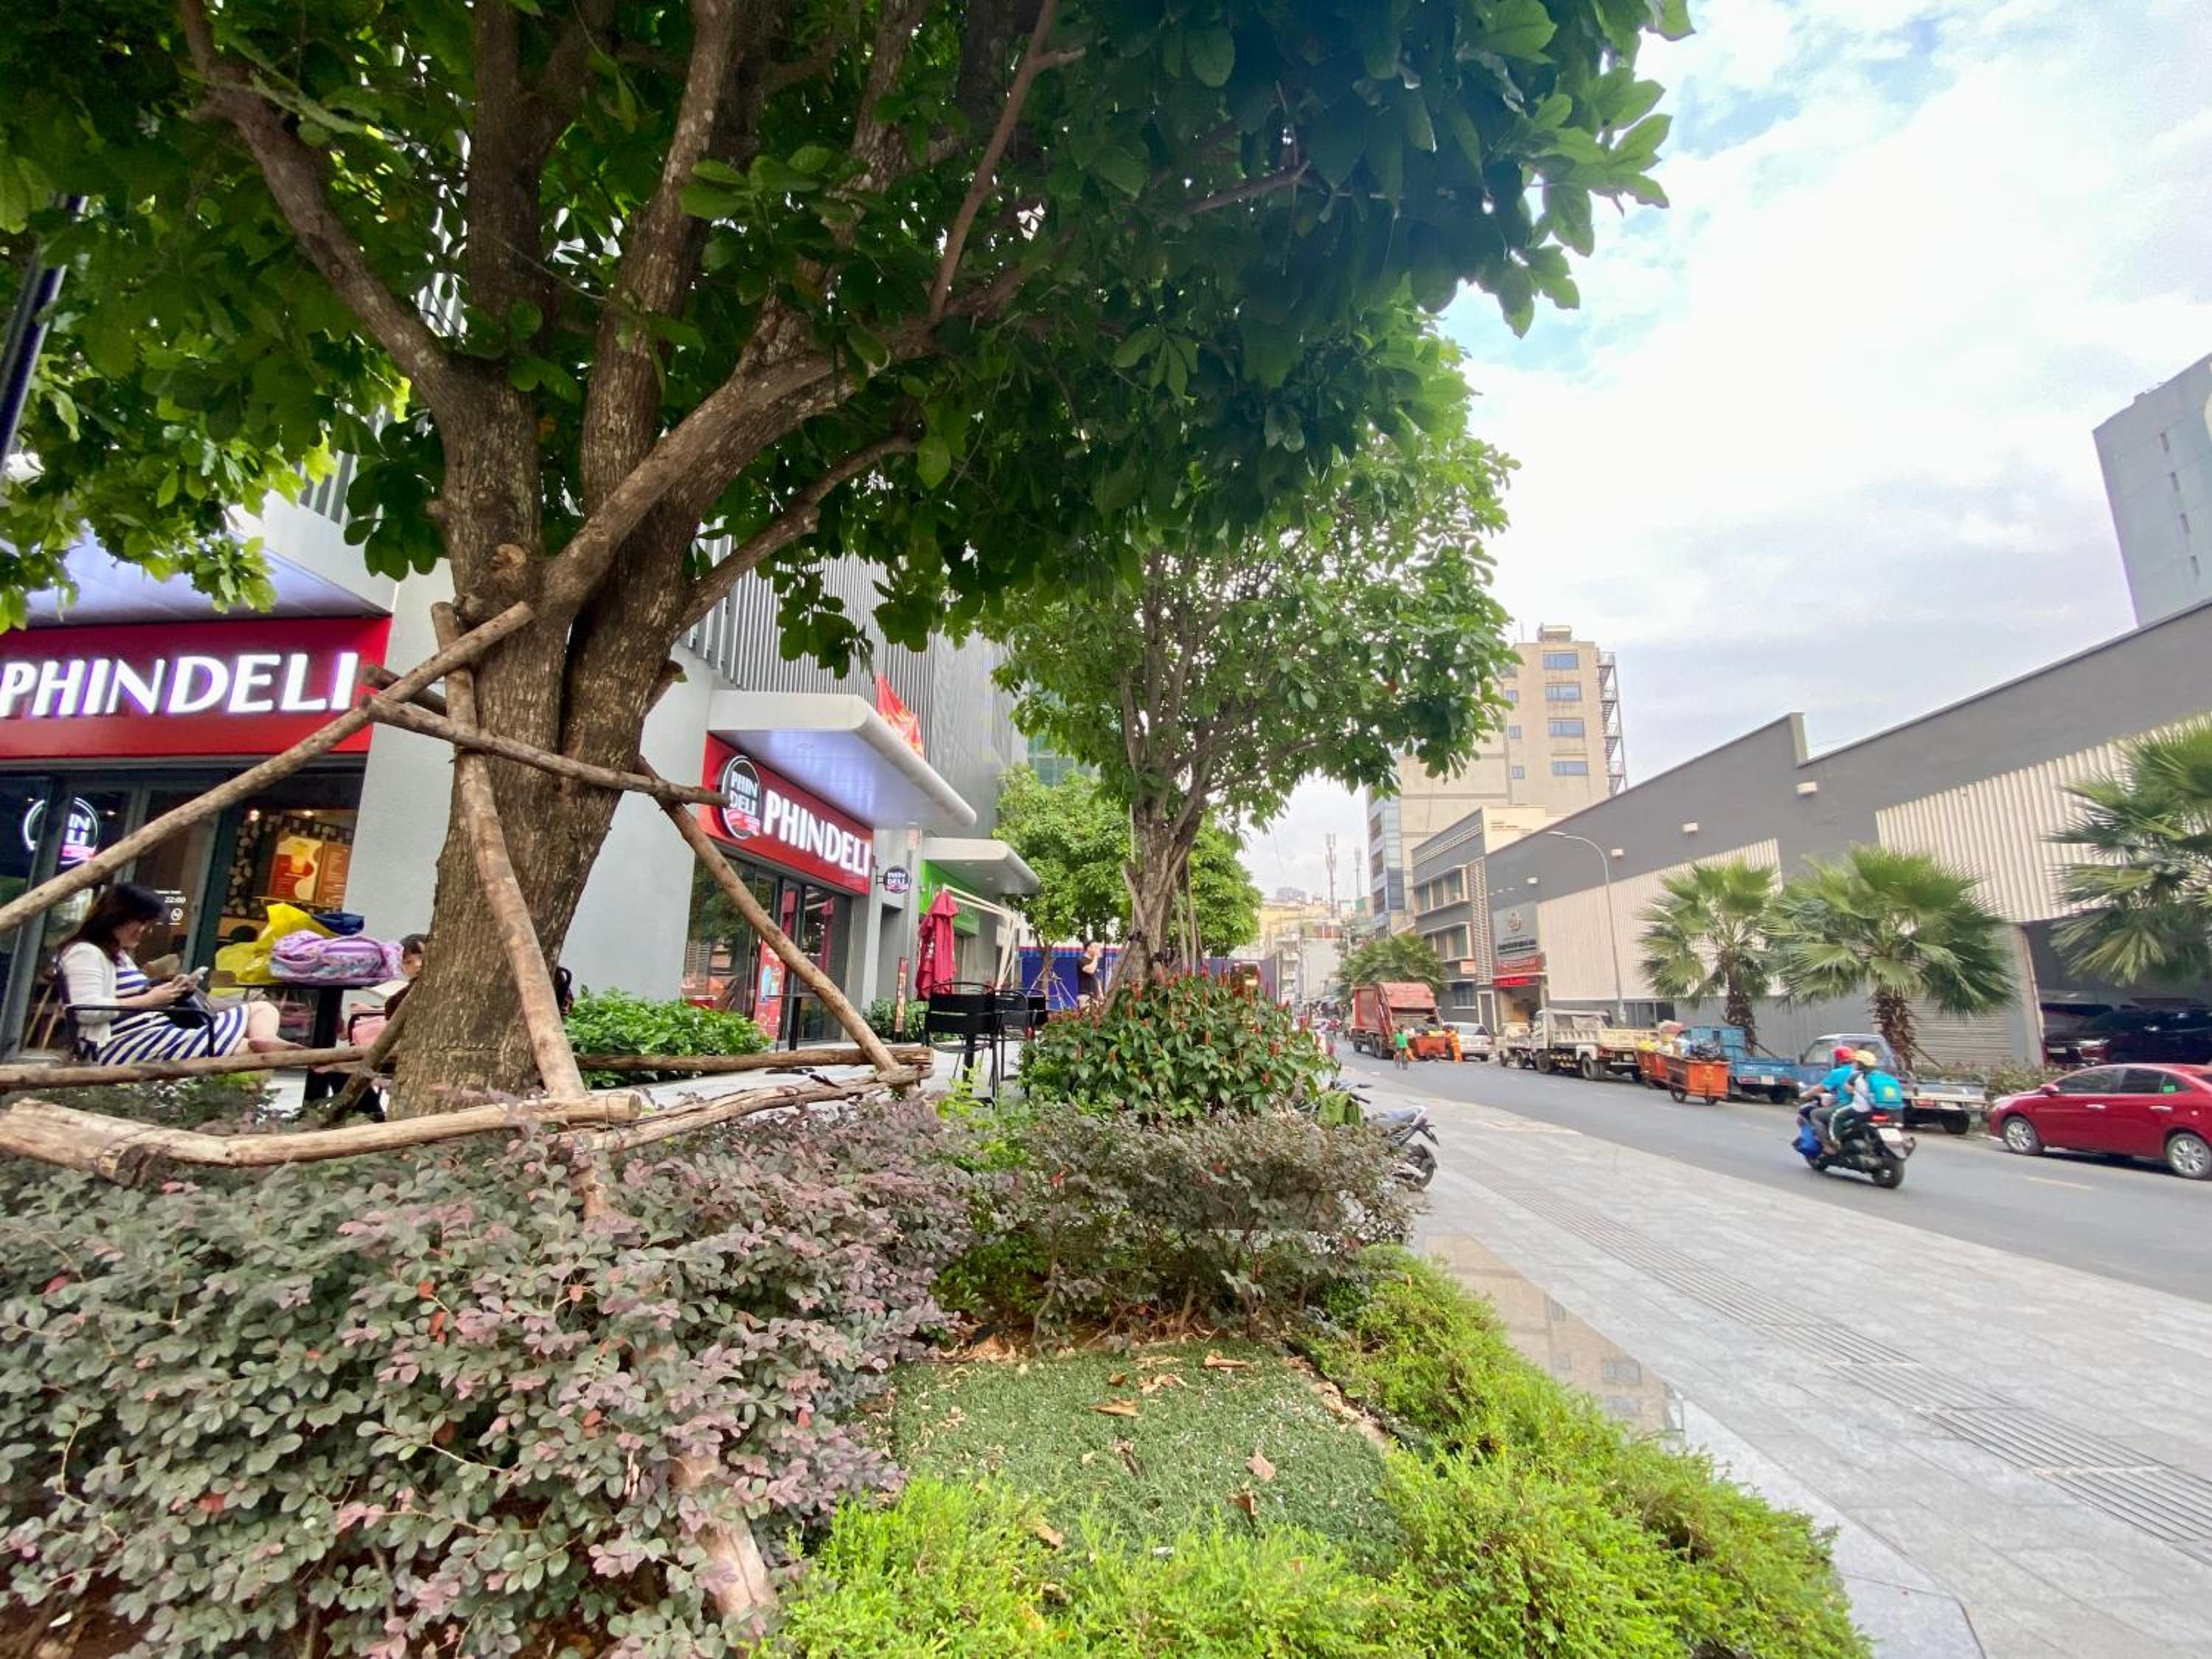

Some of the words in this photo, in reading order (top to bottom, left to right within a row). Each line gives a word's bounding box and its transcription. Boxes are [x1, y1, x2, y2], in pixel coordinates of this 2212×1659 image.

[0, 653, 358, 718] PHINDELI
[730, 790, 756, 816] DELI
[731, 771, 758, 798] PHIN
[763, 789, 870, 877] PHINDELI
